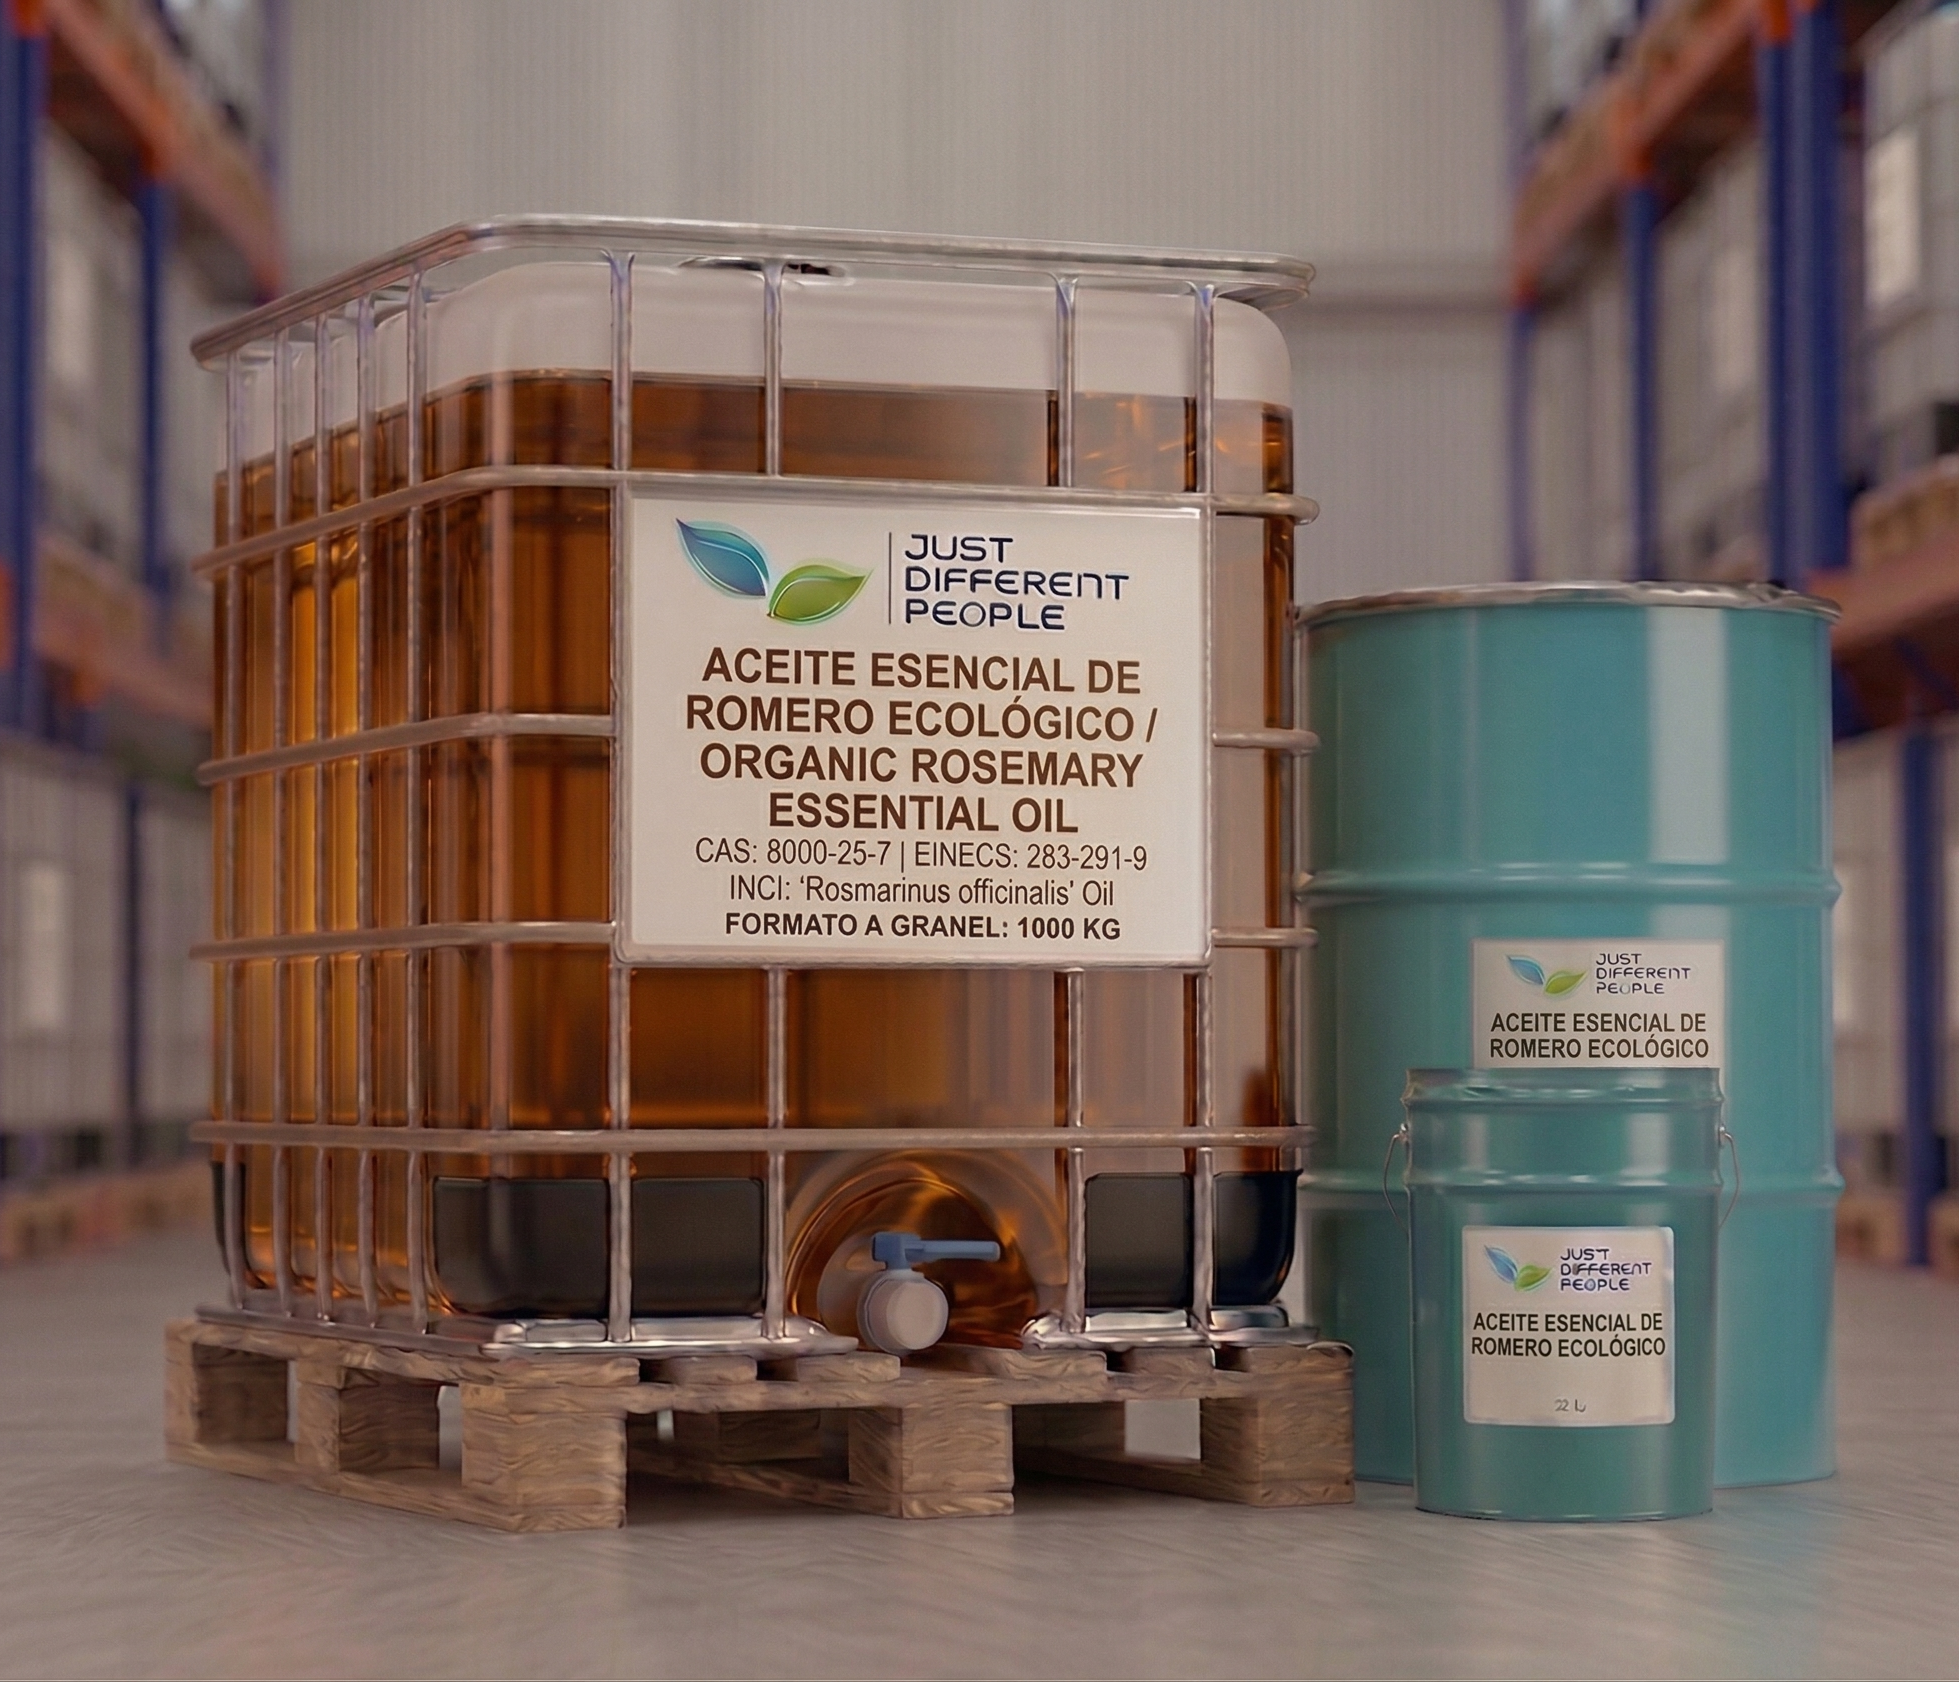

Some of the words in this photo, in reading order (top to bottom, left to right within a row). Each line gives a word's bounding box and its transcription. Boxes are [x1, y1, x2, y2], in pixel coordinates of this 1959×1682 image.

[905, 535, 1013, 563] JUST
[905, 567, 1129, 600] DIFFERENT
[905, 600, 1065, 630] PEOPLE
[702, 648, 855, 686] ACEITE
[871, 653, 1075, 693] ESENCIAL
[1089, 661, 1141, 694] DE
[687, 695, 874, 735] ROMERO
[889, 695, 1134, 741] ECOLÓGICO
[700, 743, 897, 783] ORGANIC
[913, 749, 1143, 788] ROSEMARY
[770, 792, 999, 832] ESSENTIAL
[1012, 798, 1078, 833] OIL
[695, 837, 758, 864] CAS:
[767, 840, 891, 867] 8000-25-7
[914, 843, 1018, 869] EINECS:
[1026, 844, 1147, 870] 283-291-9
[730, 874, 790, 901] INCI:
[1083, 881, 1114, 906] Oil
[726, 913, 857, 936] FORMATO
[865, 915, 883, 935] A
[891, 915, 1009, 939] GRANEL:
[1017, 918, 1074, 940] 1000
[1083, 918, 1121, 940] KG
[1596, 953, 1641, 965] JUST
[1596, 968, 1691, 979] DIFFERENT
[1491, 1013, 1566, 1032] ACEITE
[1573, 1013, 1675, 1032] ESENCIAL
[1681, 1013, 1706, 1032] DE
[1491, 1039, 1581, 1058] ROMERO
[1588, 1034, 1709, 1058] ECOLÓGICO
[1560, 1248, 1609, 1260] JUST
[1473, 1313, 1538, 1331] ACEITE
[1545, 1314, 1636, 1331] ESENCIAL
[1641, 1313, 1662, 1330] DE
[1472, 1337, 1551, 1357] ROMERO
[1558, 1334, 1665, 1357] ECOLÓGICO
